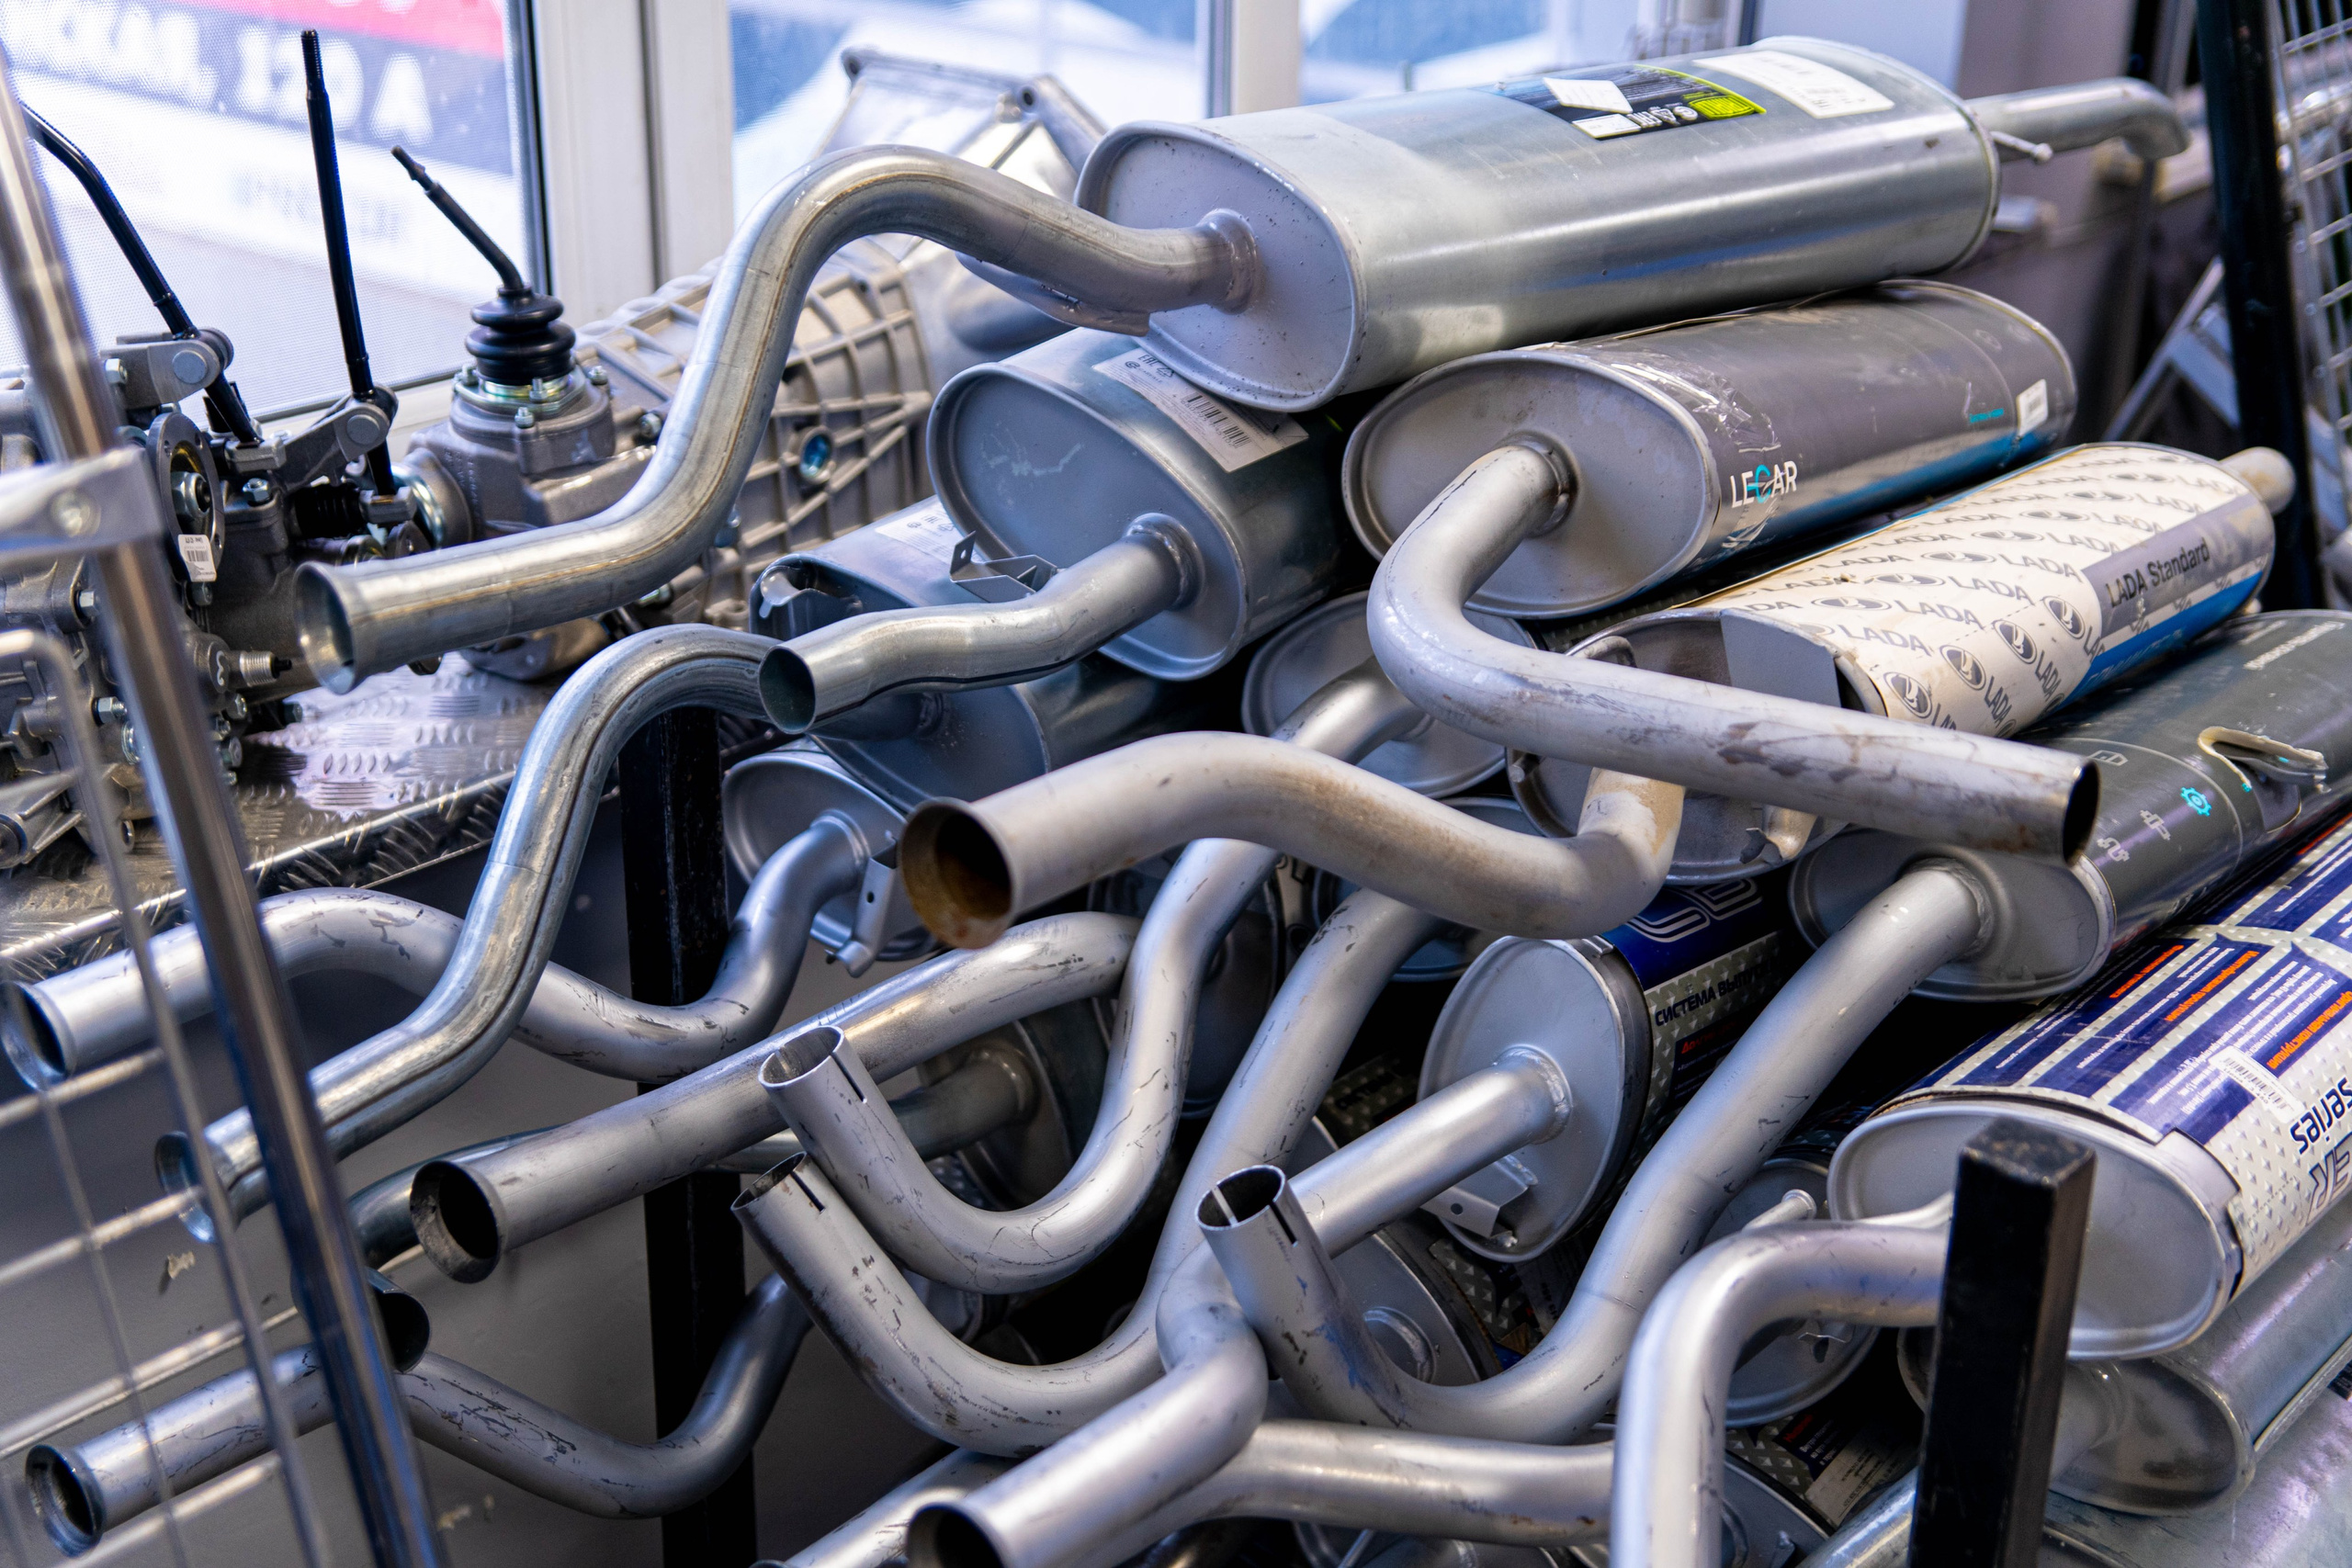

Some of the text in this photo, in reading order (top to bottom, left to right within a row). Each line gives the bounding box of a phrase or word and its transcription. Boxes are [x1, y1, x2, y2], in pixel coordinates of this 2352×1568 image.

[1730, 460, 1798, 508] LECAR
[1971, 493, 2058, 505] LADA
[1922, 513, 2012, 525] LADA
[1871, 533, 1964, 547] LADA
[1817, 555, 1914, 569] LADA
[1998, 553, 2084, 583] LADA
[2105, 536, 2211, 608] LADA Standard
[1949, 575, 2036, 605] LADA
[1894, 600, 1986, 630] LADA
[1838, 625, 1932, 657] LADA
[2035, 649, 2063, 702] LADA
[1984, 675, 2013, 728] LADA
[1655, 988, 1716, 1027] СИСТЕМА
[2290, 1077, 2352, 1155] series
